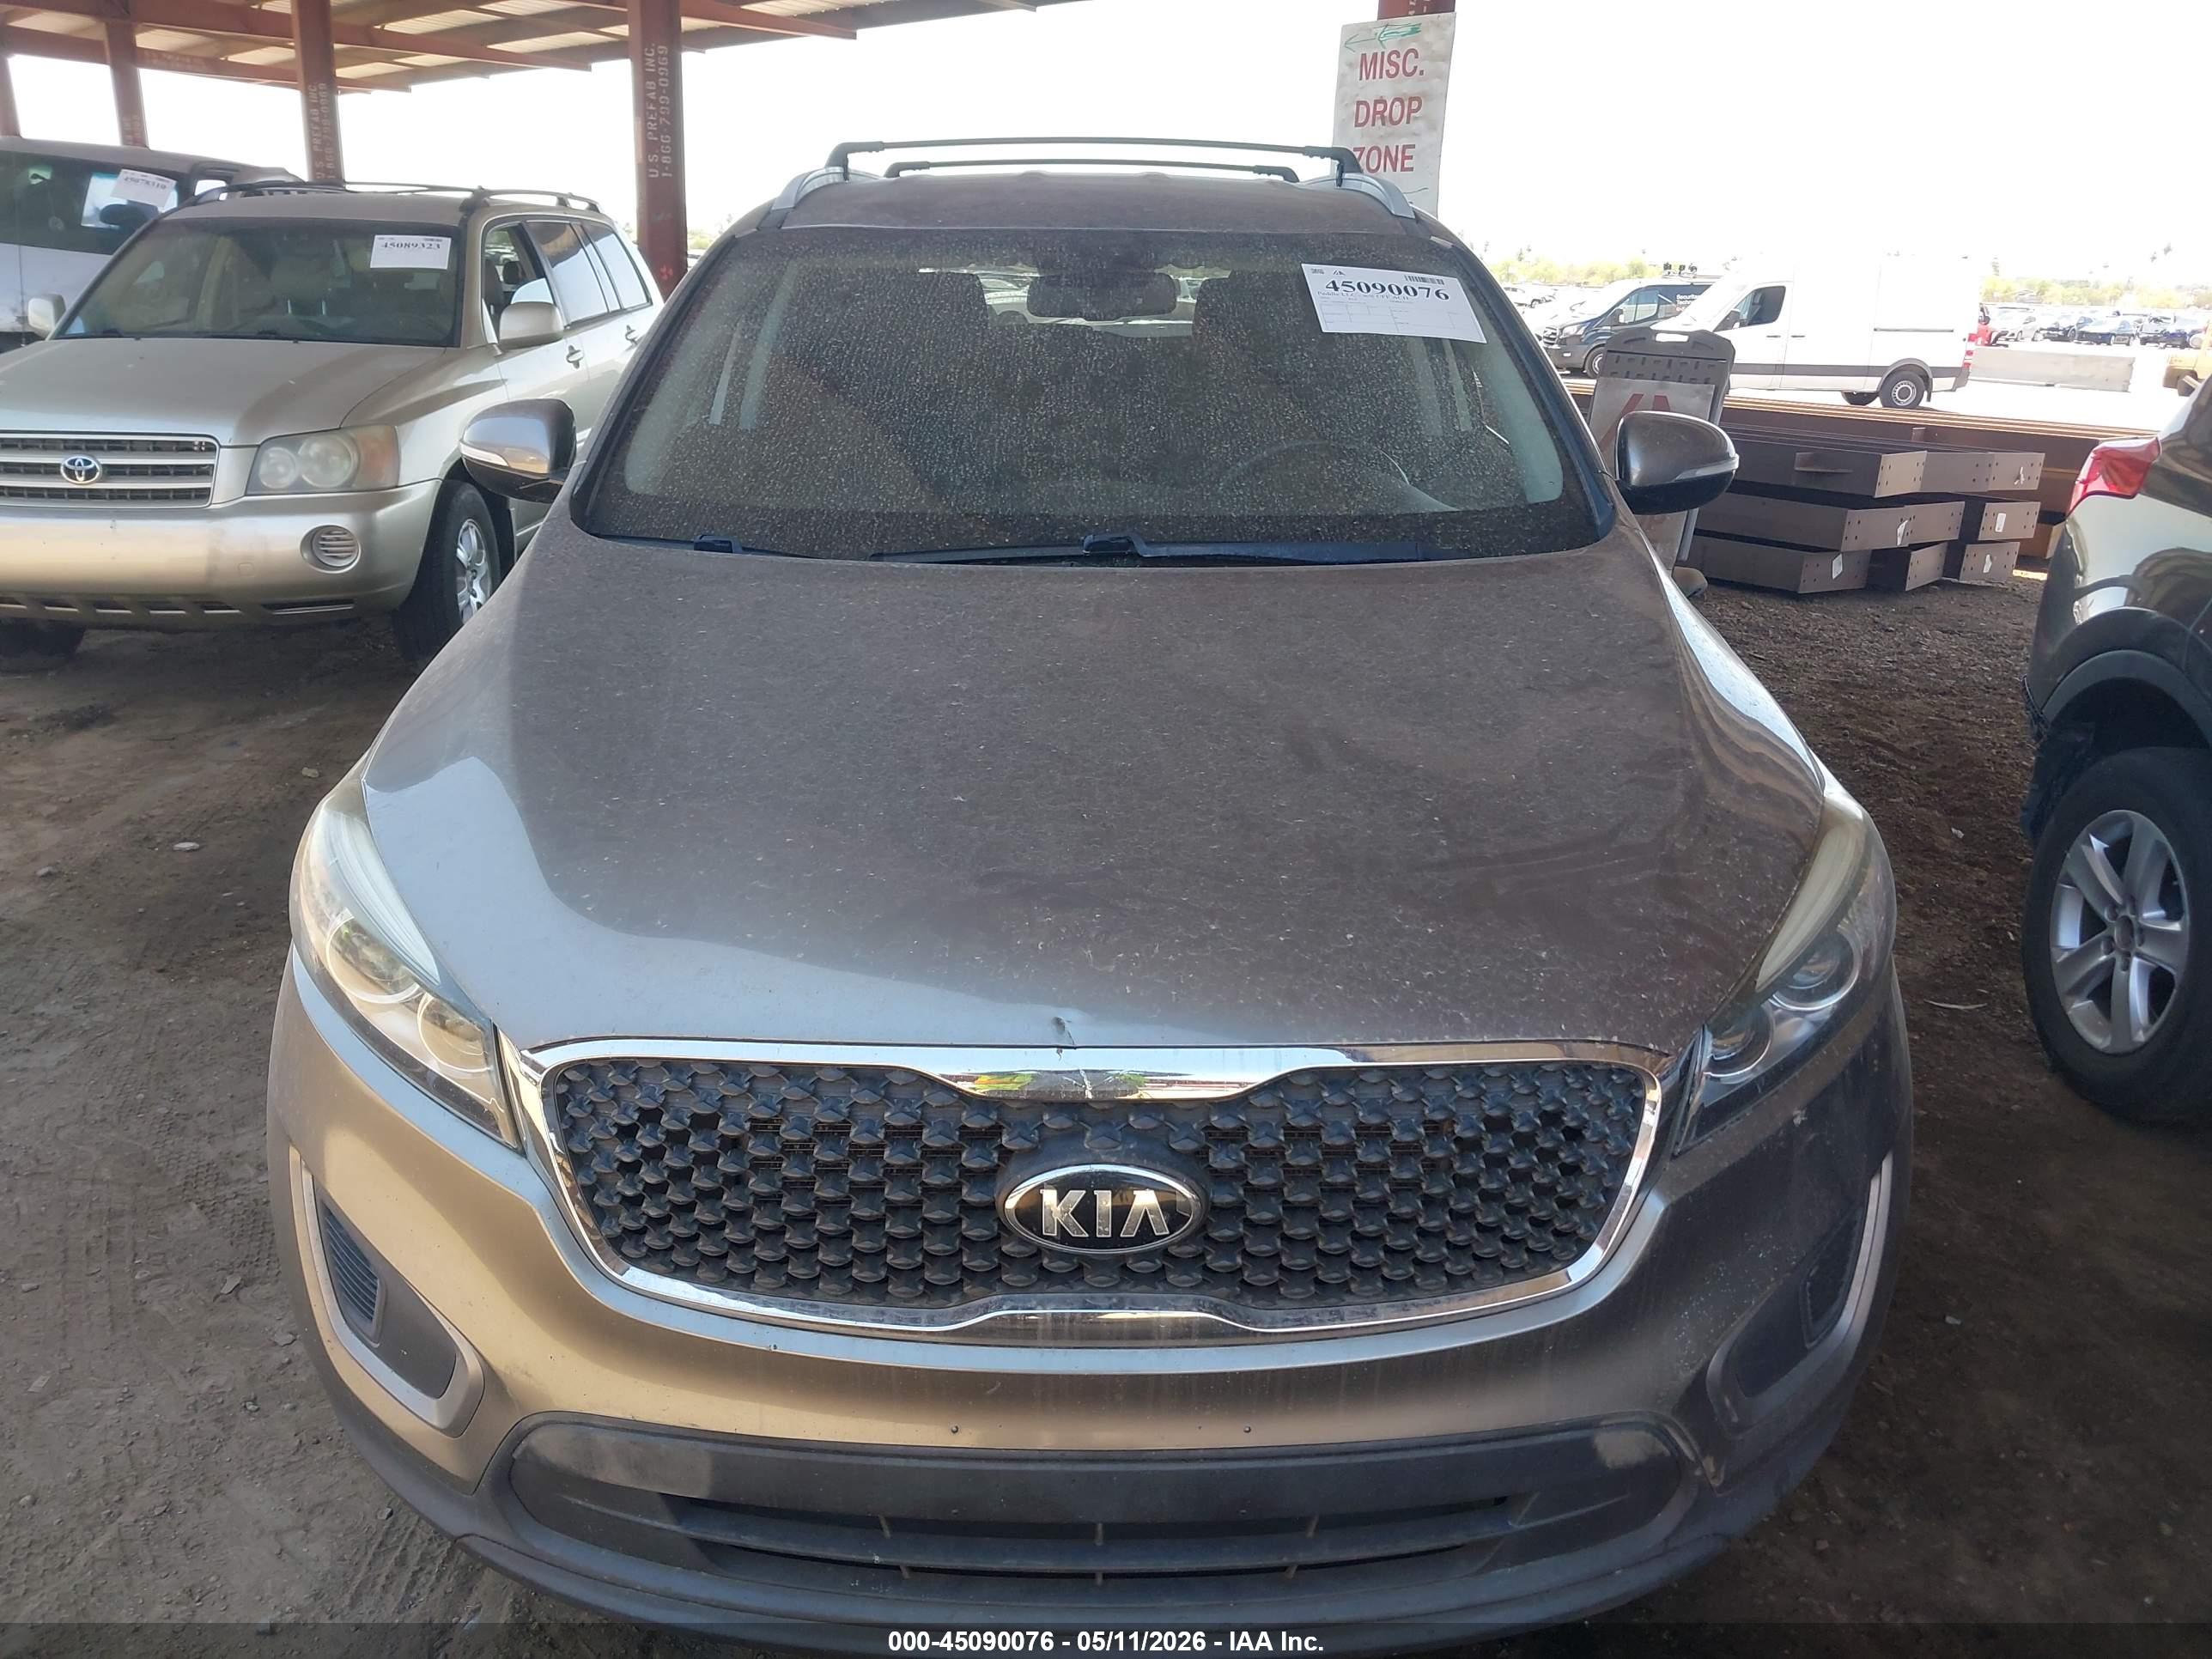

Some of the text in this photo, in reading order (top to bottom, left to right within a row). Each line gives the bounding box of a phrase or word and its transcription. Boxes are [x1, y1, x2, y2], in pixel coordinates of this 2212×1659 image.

[1358, 47, 1425, 81] MISC.
[644, 43, 659, 178] U.S. PREFAB INC.
[1354, 95, 1423, 128] DROP
[1325, 278, 1449, 301] 45090076
[1039, 1188, 1170, 1237] KIA
